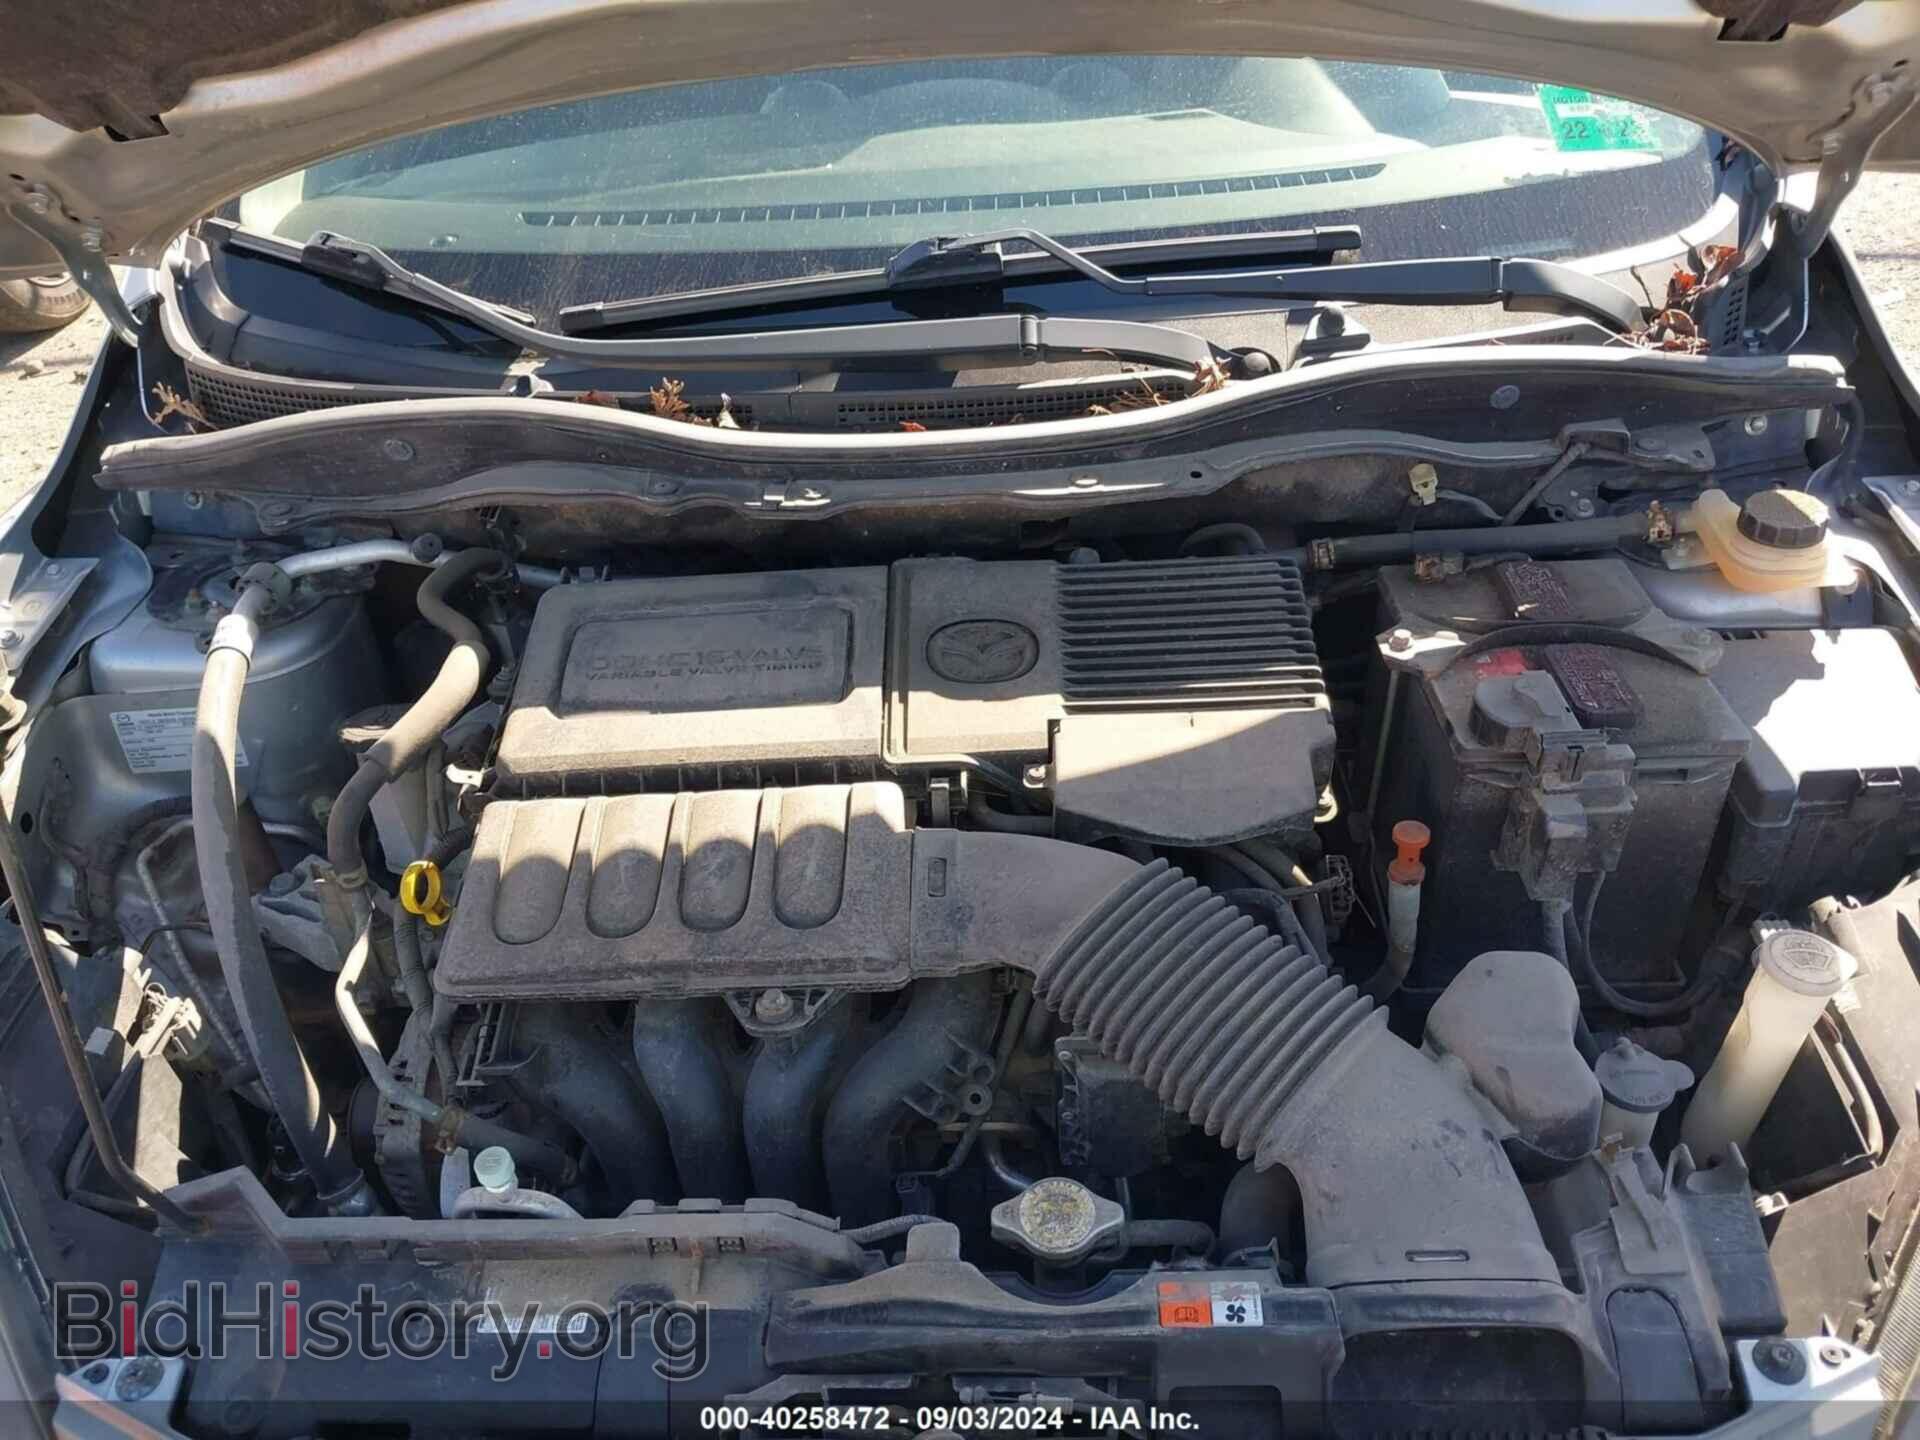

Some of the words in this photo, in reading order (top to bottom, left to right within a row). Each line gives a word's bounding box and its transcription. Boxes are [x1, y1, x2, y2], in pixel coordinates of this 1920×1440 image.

[1561, 120, 1590, 139] 22
[585, 667, 683, 681] VARIABLE
[753, 660, 824, 673] TIMING
